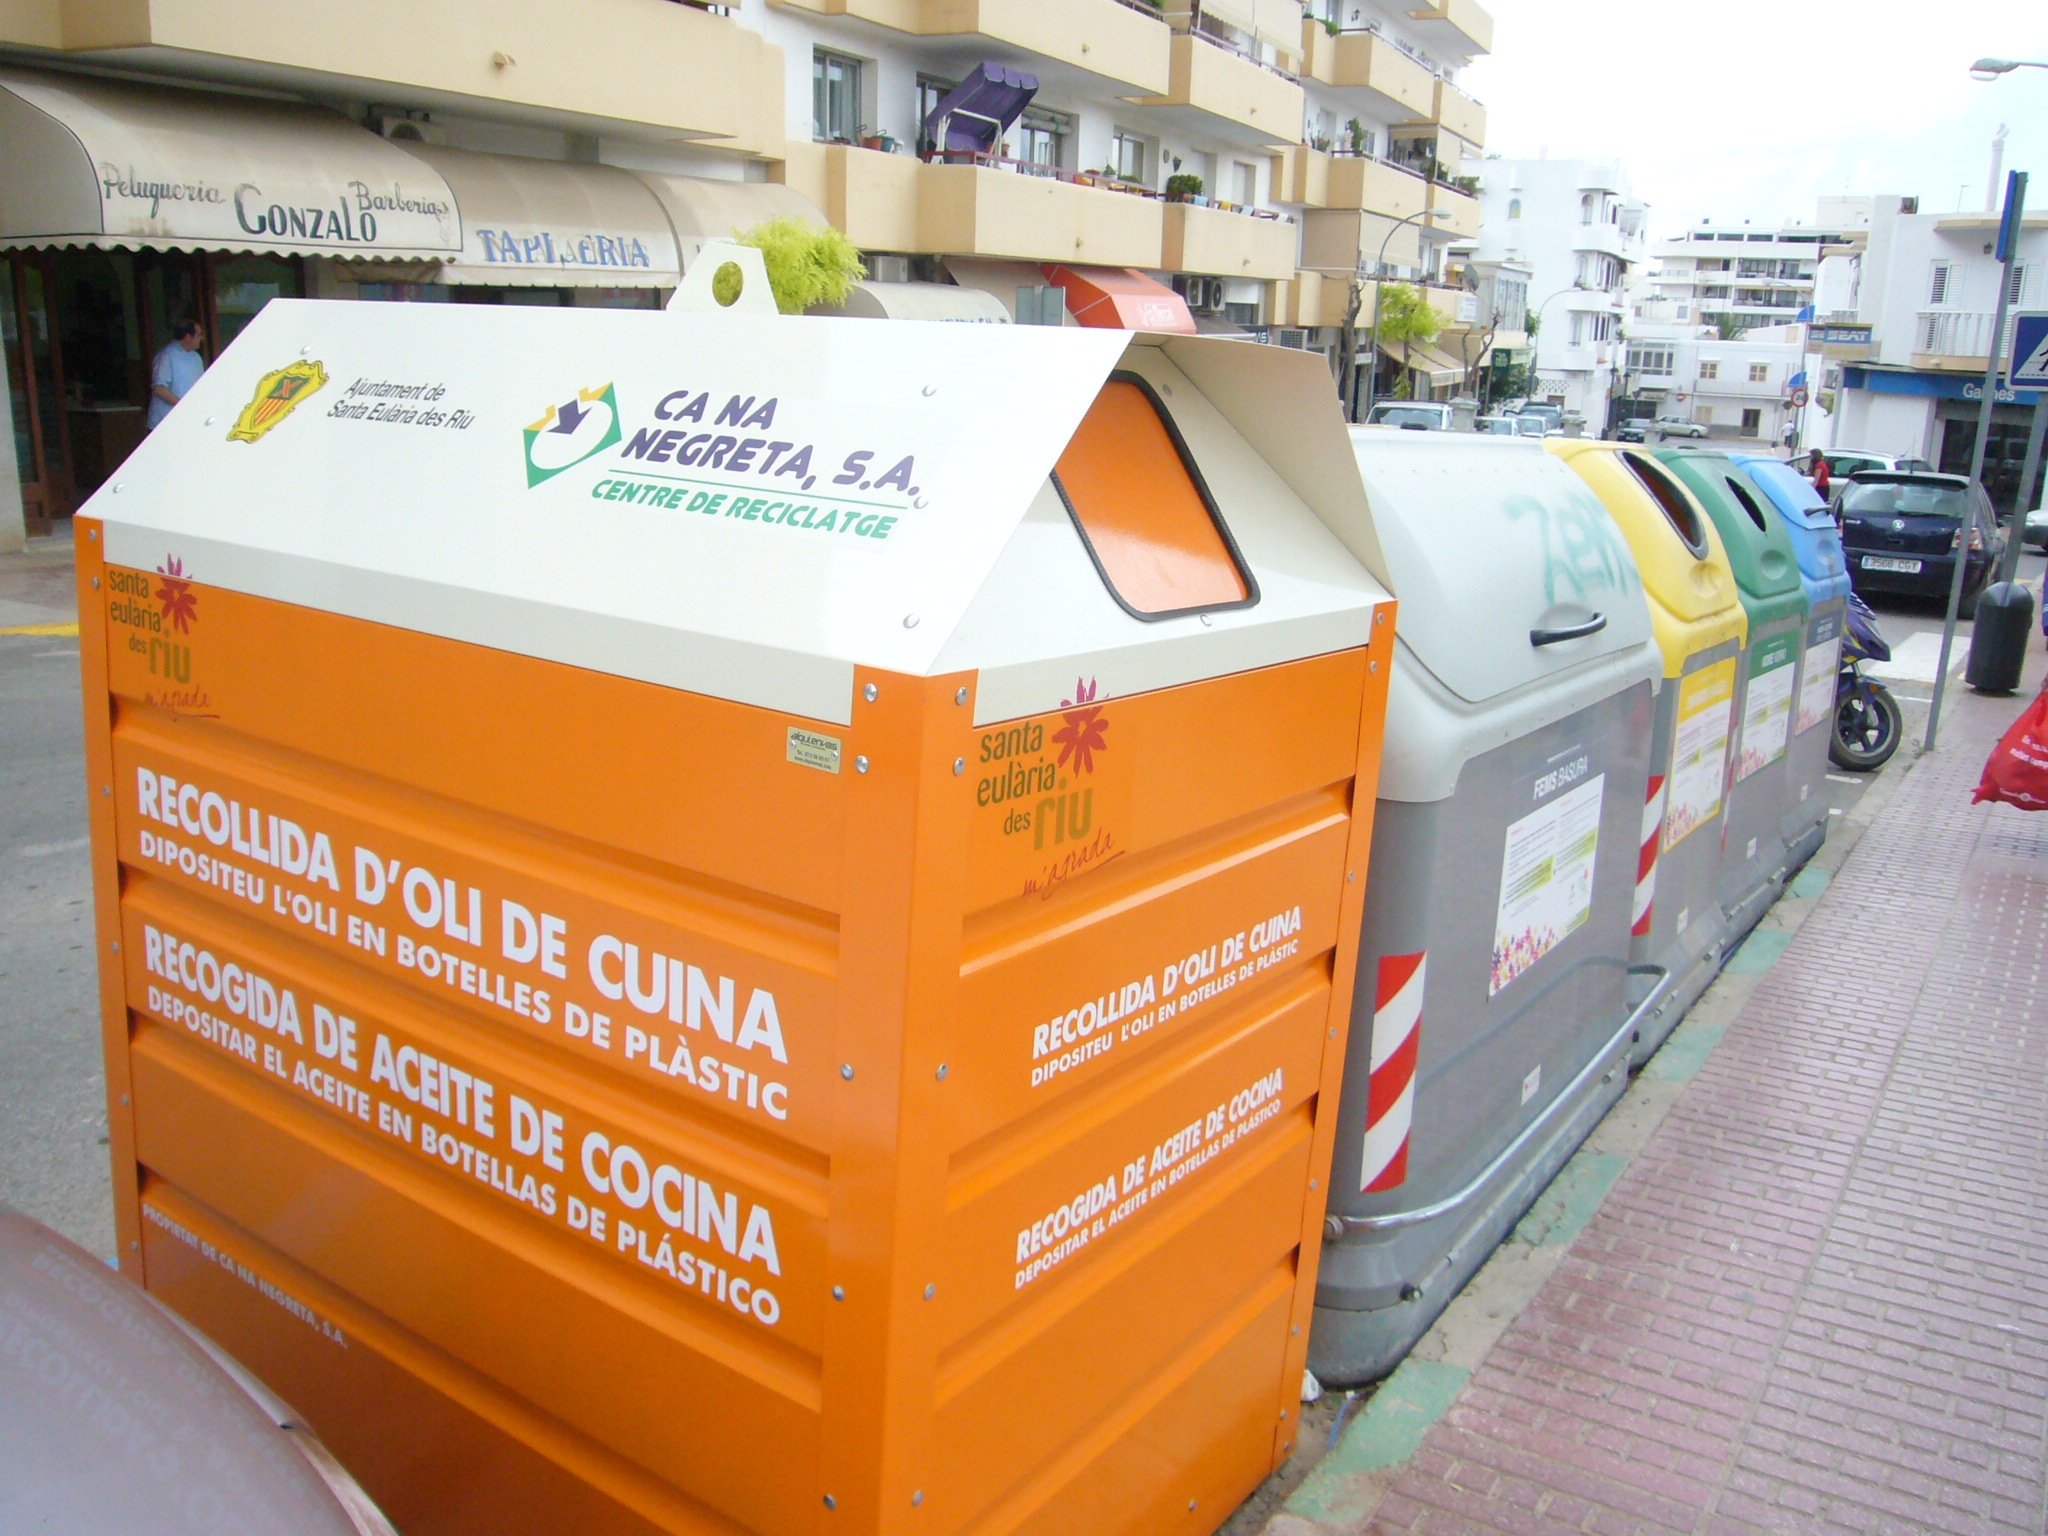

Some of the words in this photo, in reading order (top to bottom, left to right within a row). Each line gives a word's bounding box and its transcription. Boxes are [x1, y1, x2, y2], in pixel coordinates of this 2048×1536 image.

[234, 183, 377, 242] GONZALO
[1827, 329, 1869, 341] SEAT
[327, 400, 369, 419] Santa
[366, 402, 418, 424] Eulària
[416, 407, 447, 427] des
[444, 409, 475, 430] Riu
[344, 377, 428, 399] Ajuntament
[423, 382, 446, 401] de
[654, 390, 709, 424] CA
[713, 394, 778, 430] NA
[621, 428, 817, 491] NEGRETA,
[833, 450, 920, 497] S.A.
[591, 479, 689, 510] CENTRE
[685, 491, 728, 515] DE
[726, 496, 898, 539] RECICLATGE
[109, 570, 149, 598] santa
[110, 598, 161, 632] eulària
[129, 632, 147, 654] des
[150, 628, 191, 684] riu
[980, 721, 1044, 764] santa
[976, 761, 1056, 807] eulària
[1003, 808, 1031, 836] des
[1034, 777, 1093, 851] riu
[137, 767, 340, 892] RECOLLIDA
[355, 846, 482, 947] D'OLI
[502, 899, 566, 980] DE
[588, 934, 788, 1064] CUINA
[140, 830, 264, 904] DIPOSITEU
[274, 884, 337, 936] L'OLI
[348, 914, 385, 957] EN
[397, 934, 552, 1024] BOTELLES
[564, 1001, 611, 1049] DE
[625, 1025, 788, 1120] PLÀSTIC
[1033, 974, 1155, 1060] RECOLLIDA
[1163, 945, 1216, 997] D'OLI
[1221, 932, 1245, 968] DE
[1249, 906, 1301, 953] CUINA
[1031, 1032, 1113, 1087] DIPOSITEU
[1121, 1011, 1154, 1042] L'OLI
[1158, 1000, 1176, 1023] EN
[1180, 970, 1236, 1012] BOTELLES
[1239, 961, 1254, 981] DE
[1256, 939, 1298, 972] PLÀSTIC
[145, 924, 303, 1045] RECOGIDA
[313, 1003, 358, 1072] DE
[370, 1033, 494, 1139] ACEITE
[510, 1094, 564, 1173] DE
[581, 1132, 781, 1276] COCINA
[149, 985, 257, 1063] DEPOSITAR
[264, 1043, 287, 1078] EL
[293, 1060, 370, 1122] ACEITE
[378, 1102, 412, 1143] EN
[421, 1122, 556, 1216] BOTELLAS
[567, 1195, 606, 1242] DE
[618, 1220, 780, 1325] PLÁSTICO
[1016, 1174, 1116, 1264] RECOGIDA
[1122, 1155, 1146, 1195] DE
[1149, 1119, 1202, 1177] ACEITE
[1205, 1104, 1226, 1140] DE
[1229, 1067, 1282, 1123] COCINA
[1015, 1228, 1089, 1290] DEPOSITAR
[1092, 1217, 1106, 1238] EL
[1108, 1188, 1148, 1227] ACEITE
[1151, 1175, 1166, 1198] EN
[1169, 1139, 1220, 1186] BOTELLAS
[1222, 1129, 1236, 1149] DE
[1237, 1099, 1281, 1139] PLÁSTICO
[142, 1203, 198, 1249] PROPIETAT
[201, 1241, 218, 1262] DE
[219, 1253, 235, 1274] CA
[237, 1264, 256, 1287] NA
